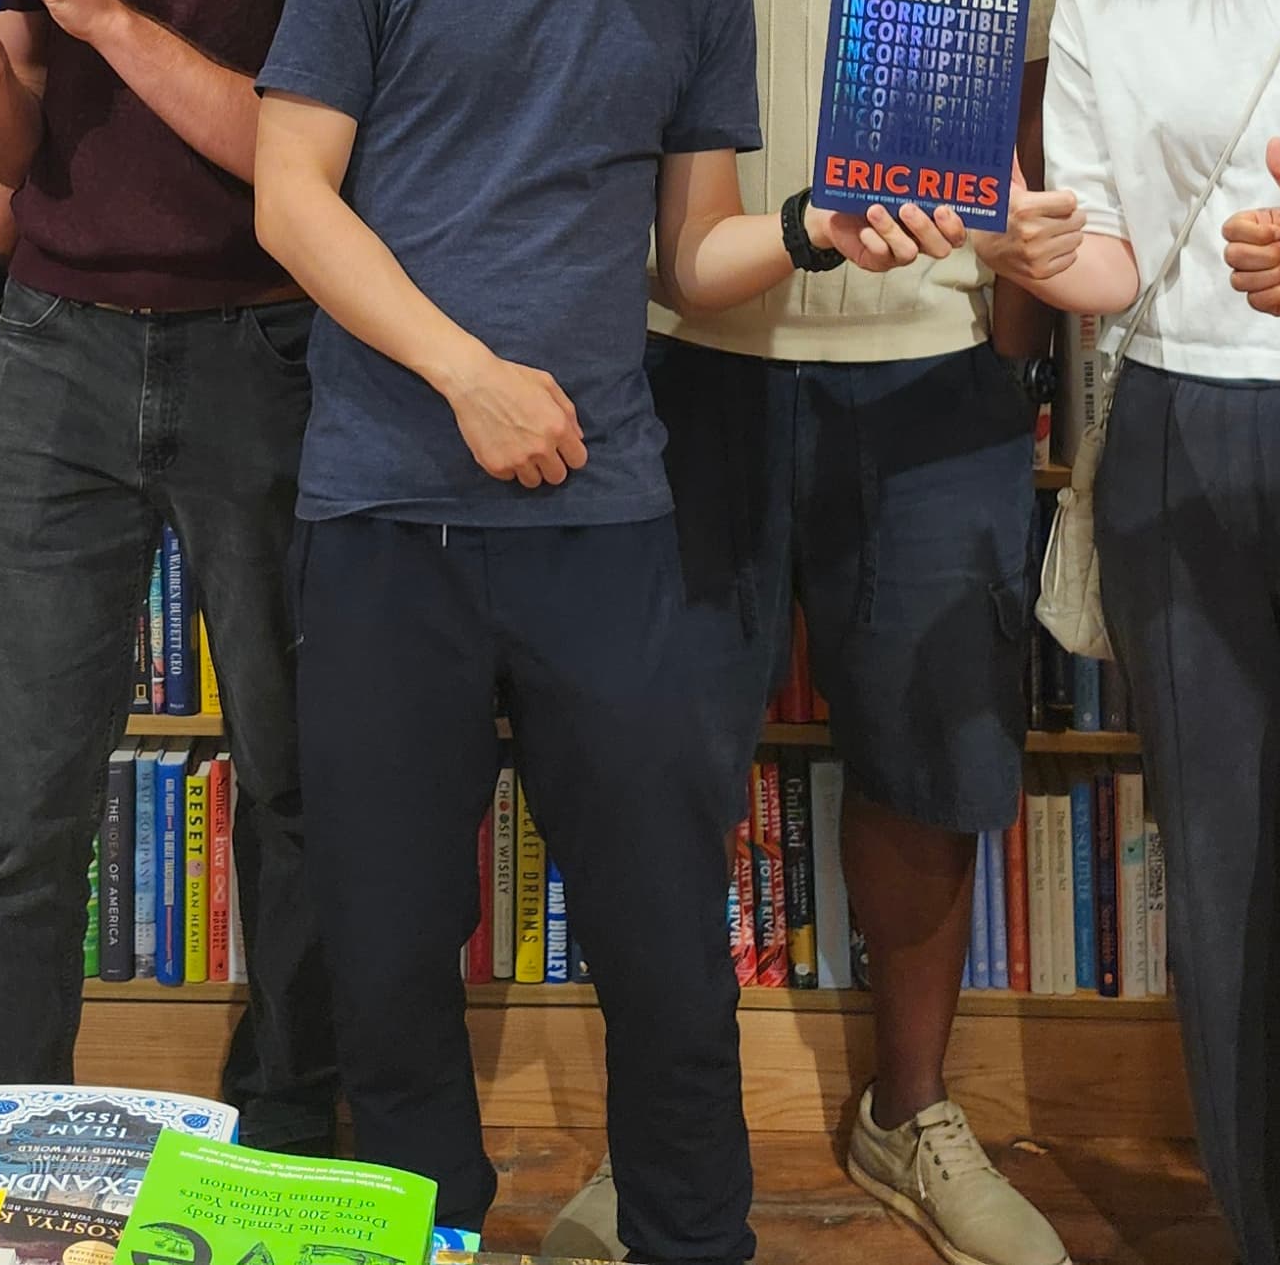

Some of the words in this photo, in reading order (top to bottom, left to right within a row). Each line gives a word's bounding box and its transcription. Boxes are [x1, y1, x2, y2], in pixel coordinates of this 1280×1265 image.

[824, 155, 912, 194] ERIC
[917, 167, 1000, 207] RIES
[189, 785, 203, 855] RESET
[67, 1110, 120, 1124] ISSA
[47, 1124, 127, 1139] ISLAM
[200, 1177, 281, 1202] Evolution
[179, 1189, 221, 1208] Years
[289, 1193, 351, 1208] Human
[357, 1198, 376, 1209] of
[184, 1204, 226, 1225] Body
[230, 1200, 293, 1218] Million
[298, 1209, 328, 1221] 200
[233, 1216, 293, 1234] Female
[335, 1212, 387, 1229] Drove
[300, 1223, 327, 1236] the
[331, 1227, 374, 1241] How
